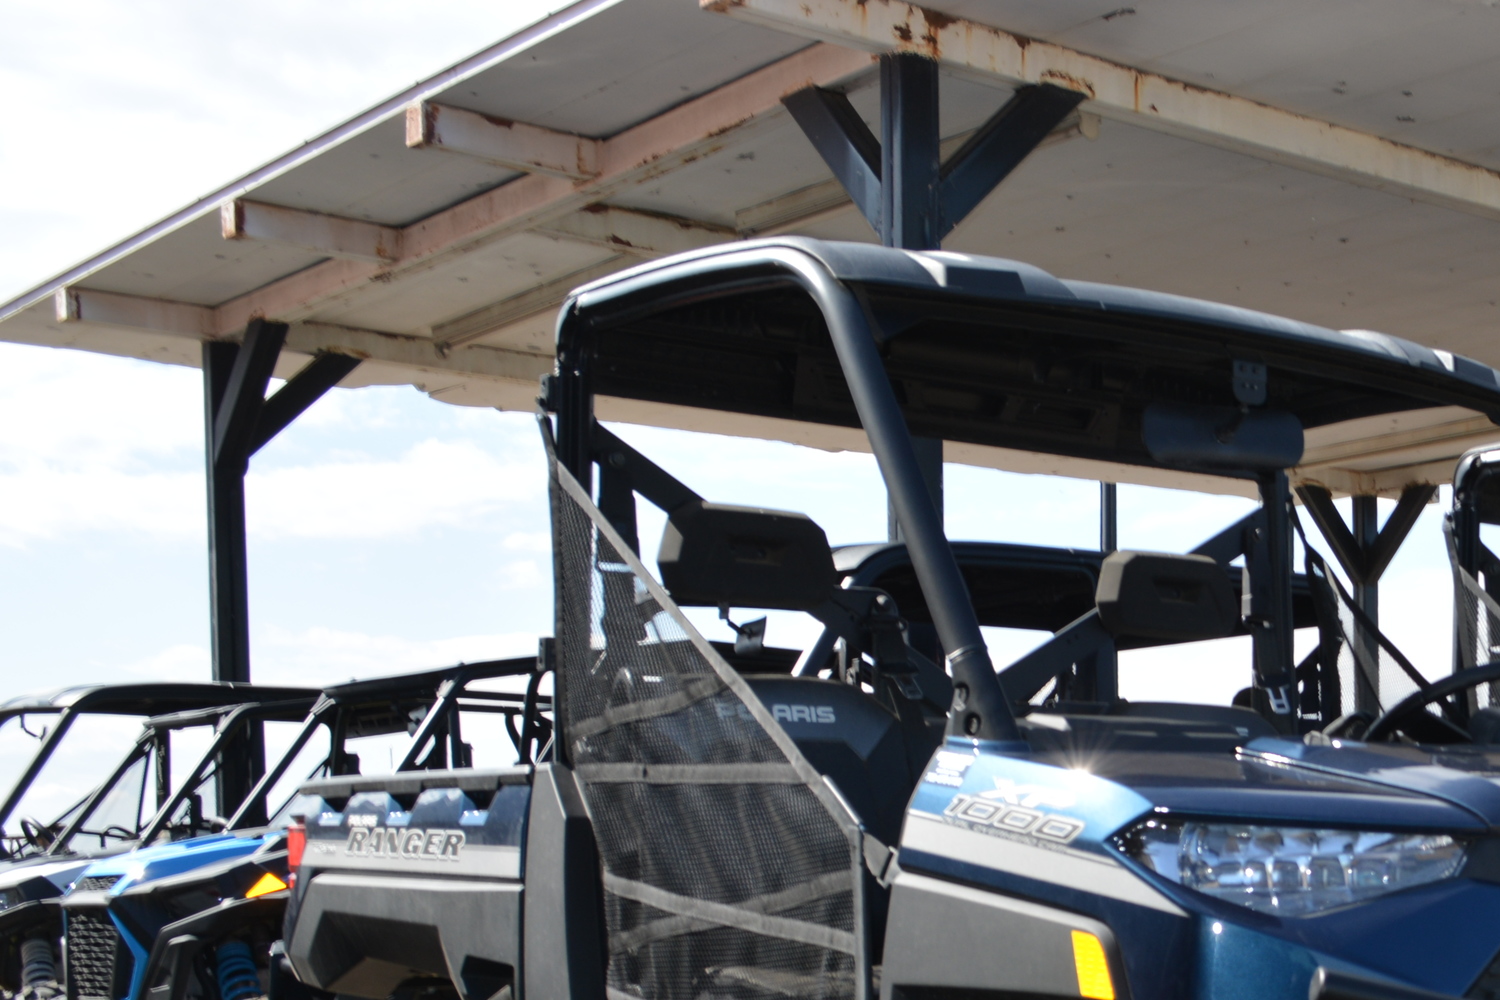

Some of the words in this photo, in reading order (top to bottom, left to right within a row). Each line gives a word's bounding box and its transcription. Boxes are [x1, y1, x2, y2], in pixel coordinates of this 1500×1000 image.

[715, 703, 835, 724] POARIS
[978, 775, 1077, 809] XP
[943, 793, 1086, 844] 1000
[345, 827, 466, 862] RANGER
